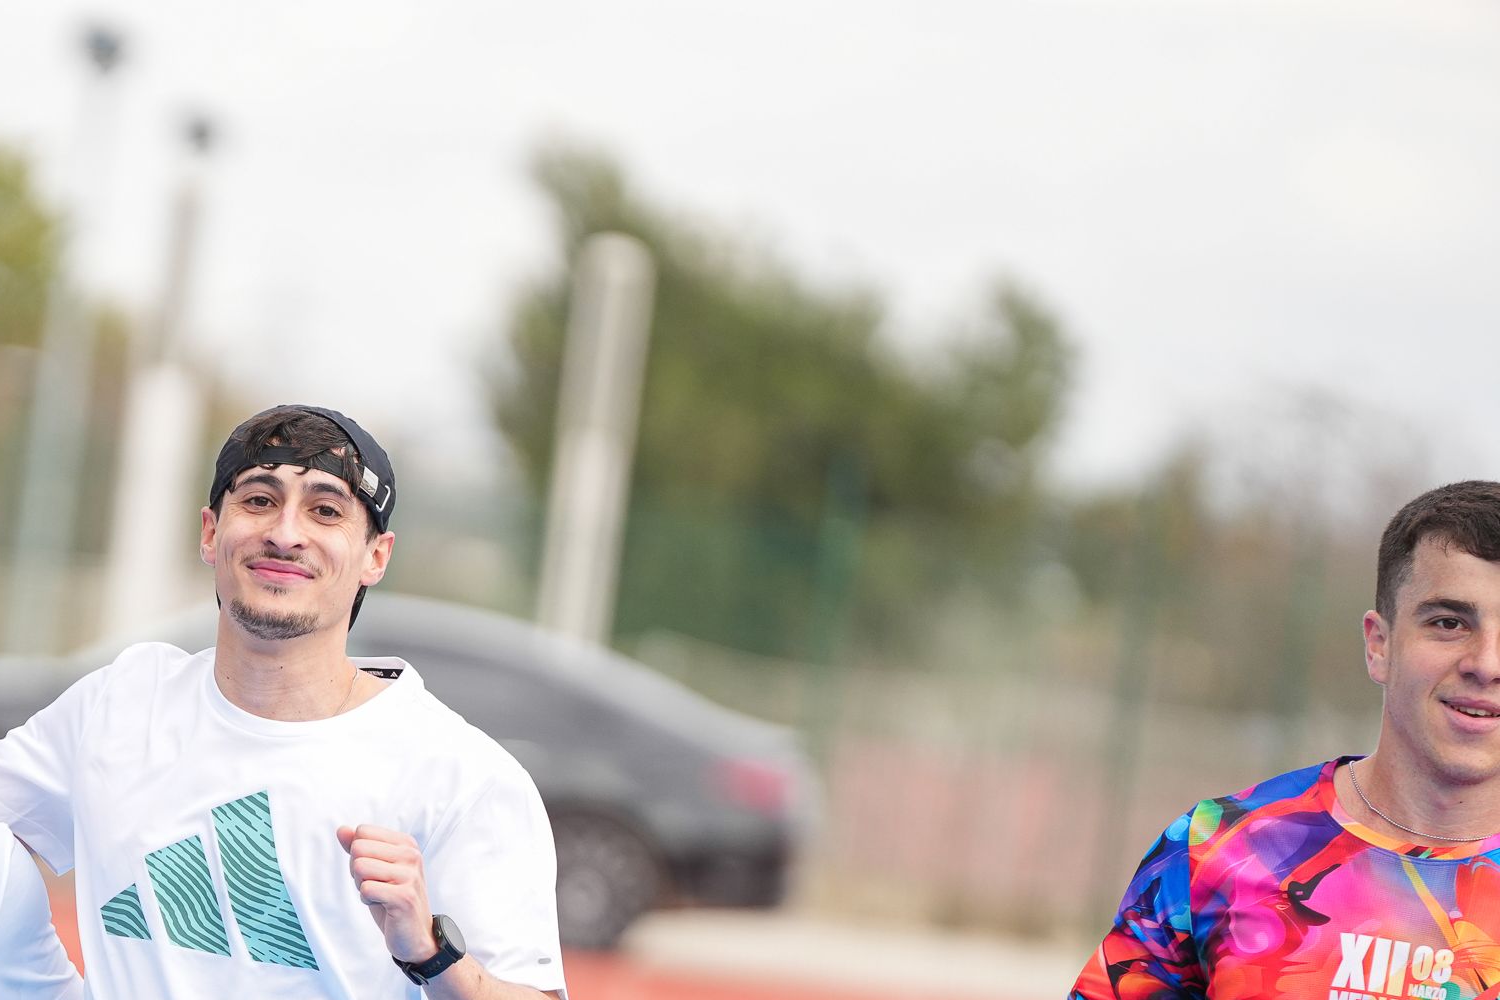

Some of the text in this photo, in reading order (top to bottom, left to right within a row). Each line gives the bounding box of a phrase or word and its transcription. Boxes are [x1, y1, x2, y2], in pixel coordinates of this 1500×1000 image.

[1331, 932, 1411, 997] XII
[1411, 945, 1455, 984] 08
[1407, 983, 1447, 1000] MARZO
